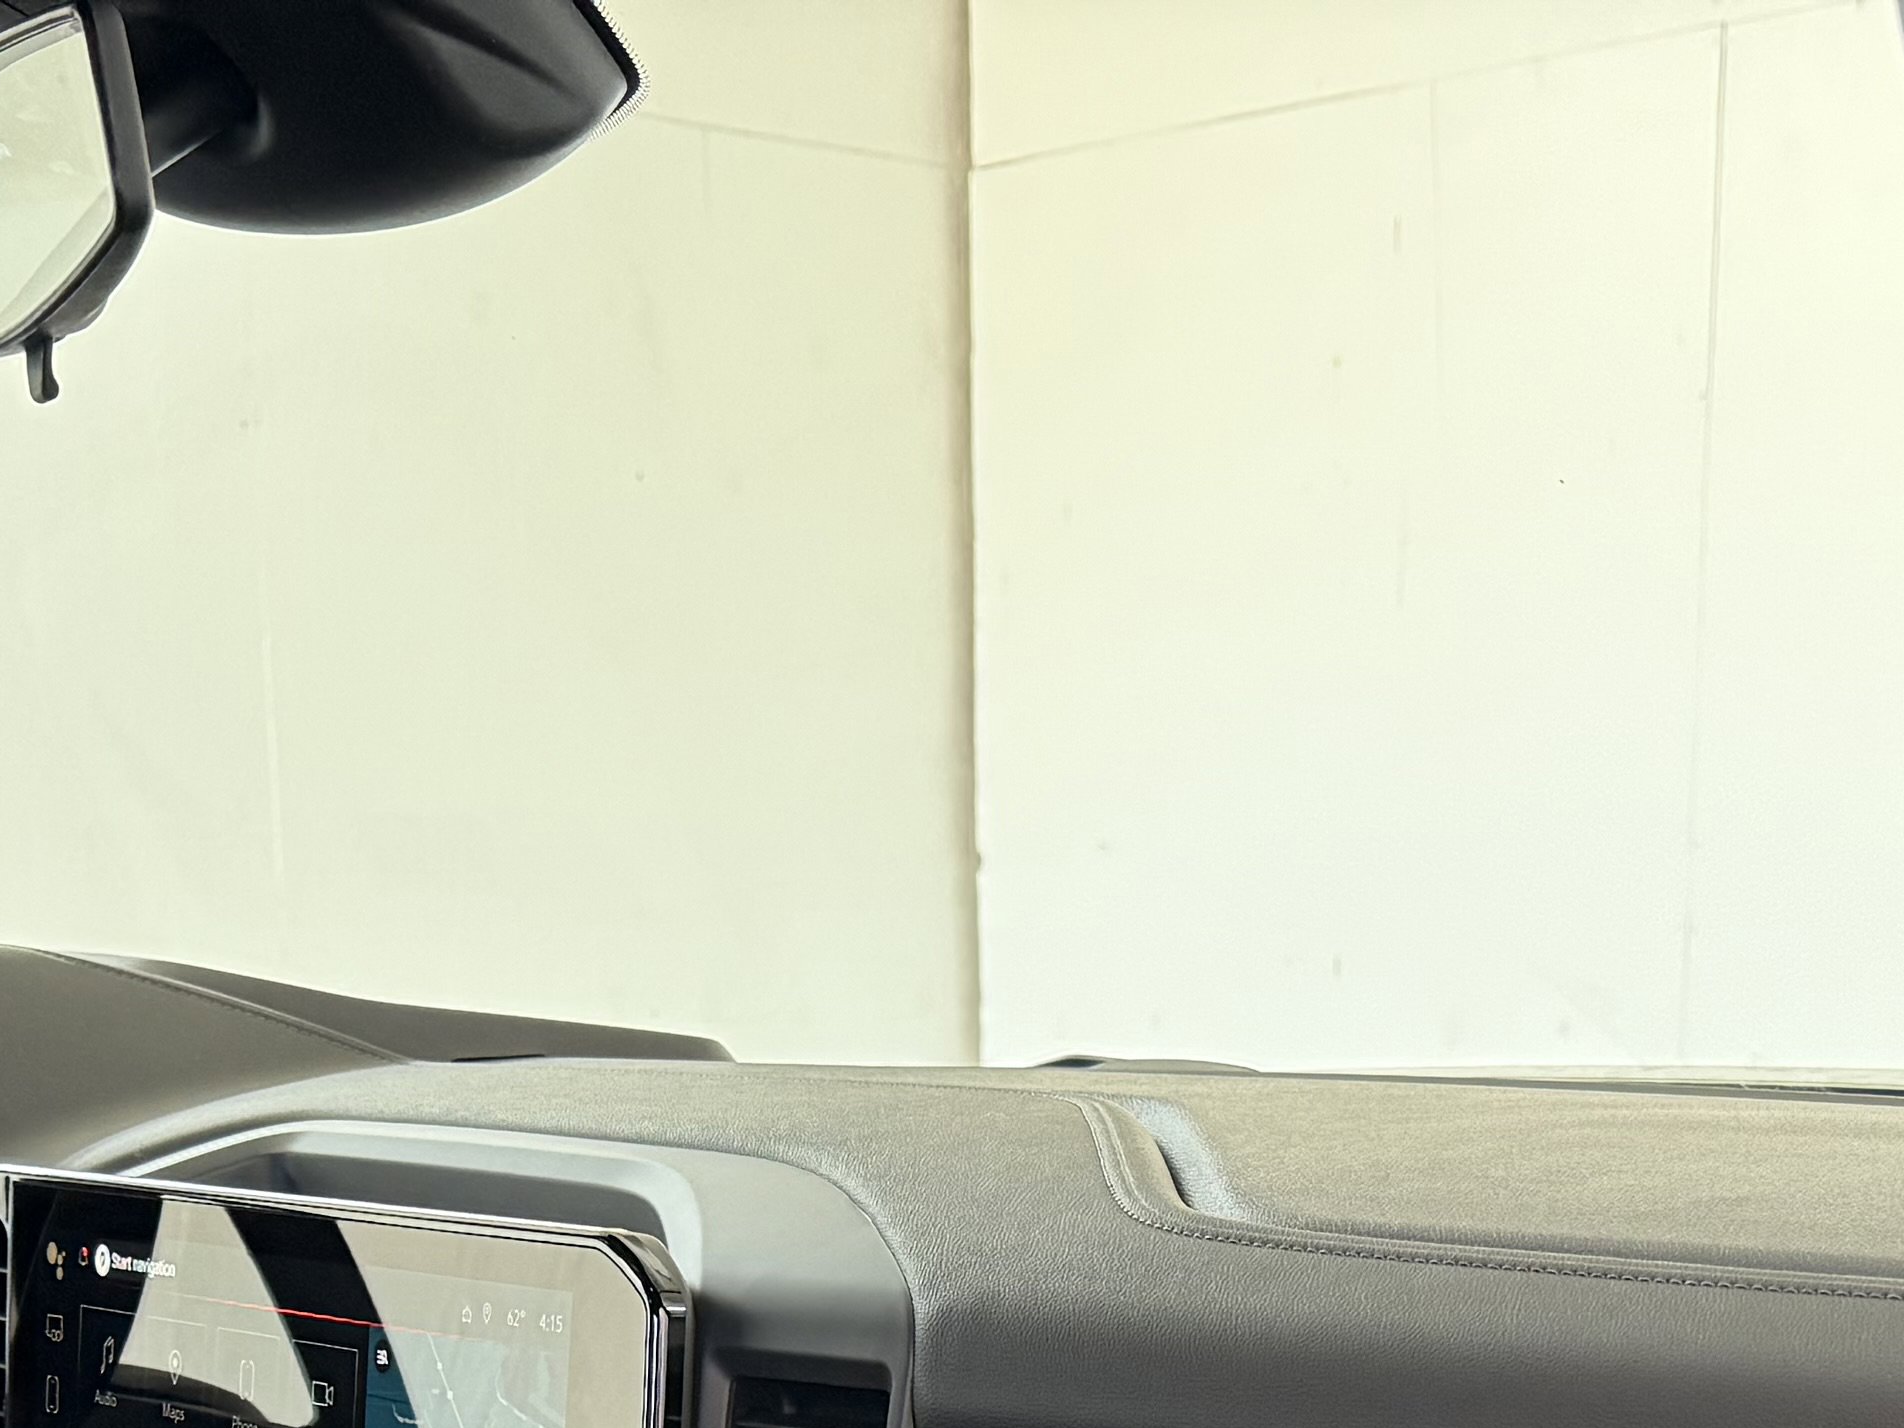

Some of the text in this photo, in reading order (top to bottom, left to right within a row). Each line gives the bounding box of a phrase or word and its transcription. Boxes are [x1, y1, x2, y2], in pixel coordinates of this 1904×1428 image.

[507, 1308, 564, 1333] 62° 4:15
[162, 1402, 185, 1422] Maps
